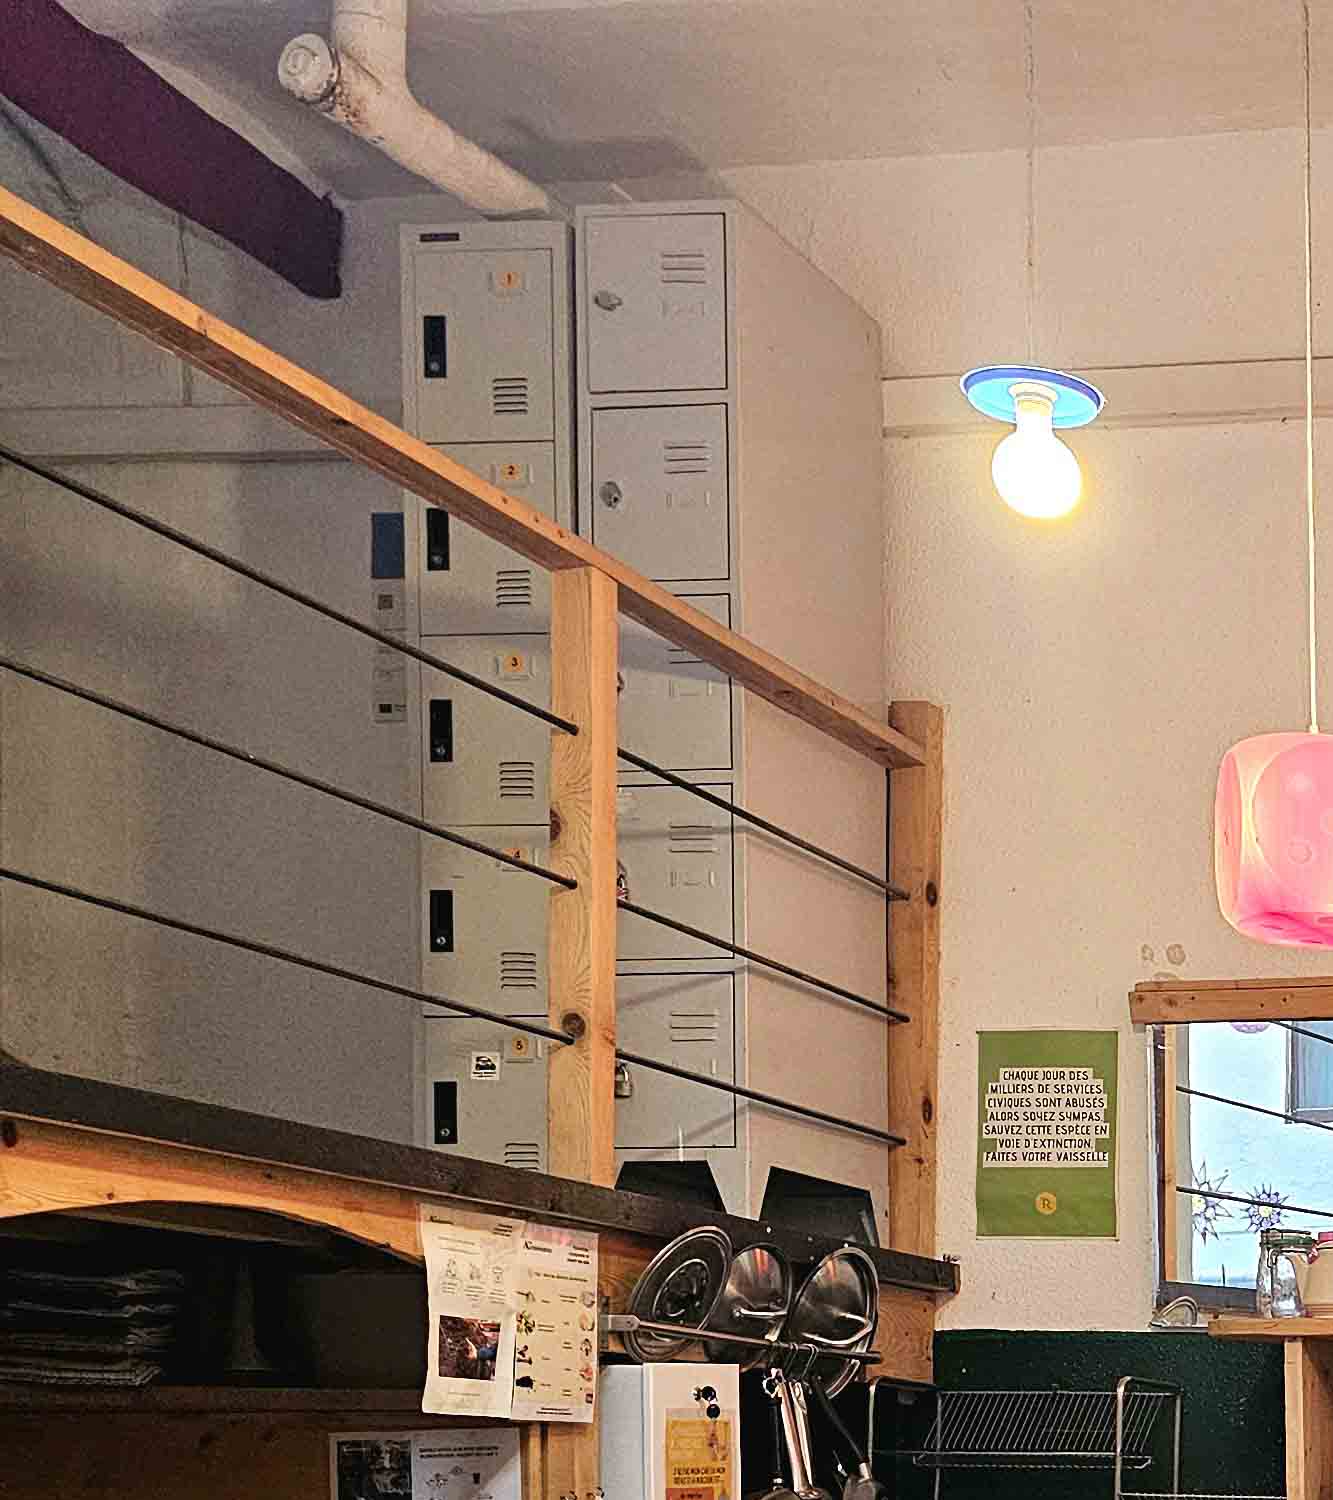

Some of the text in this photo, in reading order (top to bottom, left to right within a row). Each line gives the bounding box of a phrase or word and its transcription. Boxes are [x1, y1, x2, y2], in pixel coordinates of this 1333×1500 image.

[1002, 1070, 1090, 1081] CHAQUE JOUR DES
[990, 1083, 1104, 1095] MILLIERS DE SERVICES
[987, 1096, 1106, 1109] CIVIQUES SONT ABUSÉS
[988, 1110, 1020, 1122] ALORS
[1022, 1111, 1056, 1122] SOYEZ
[983, 1123, 1108, 1136] SAUVEZ CETTE ESPÈCE EN
[998, 1138, 1022, 1149] VOIE
[984, 1151, 1109, 1163] FAITES VOTRE VAISSELLE
